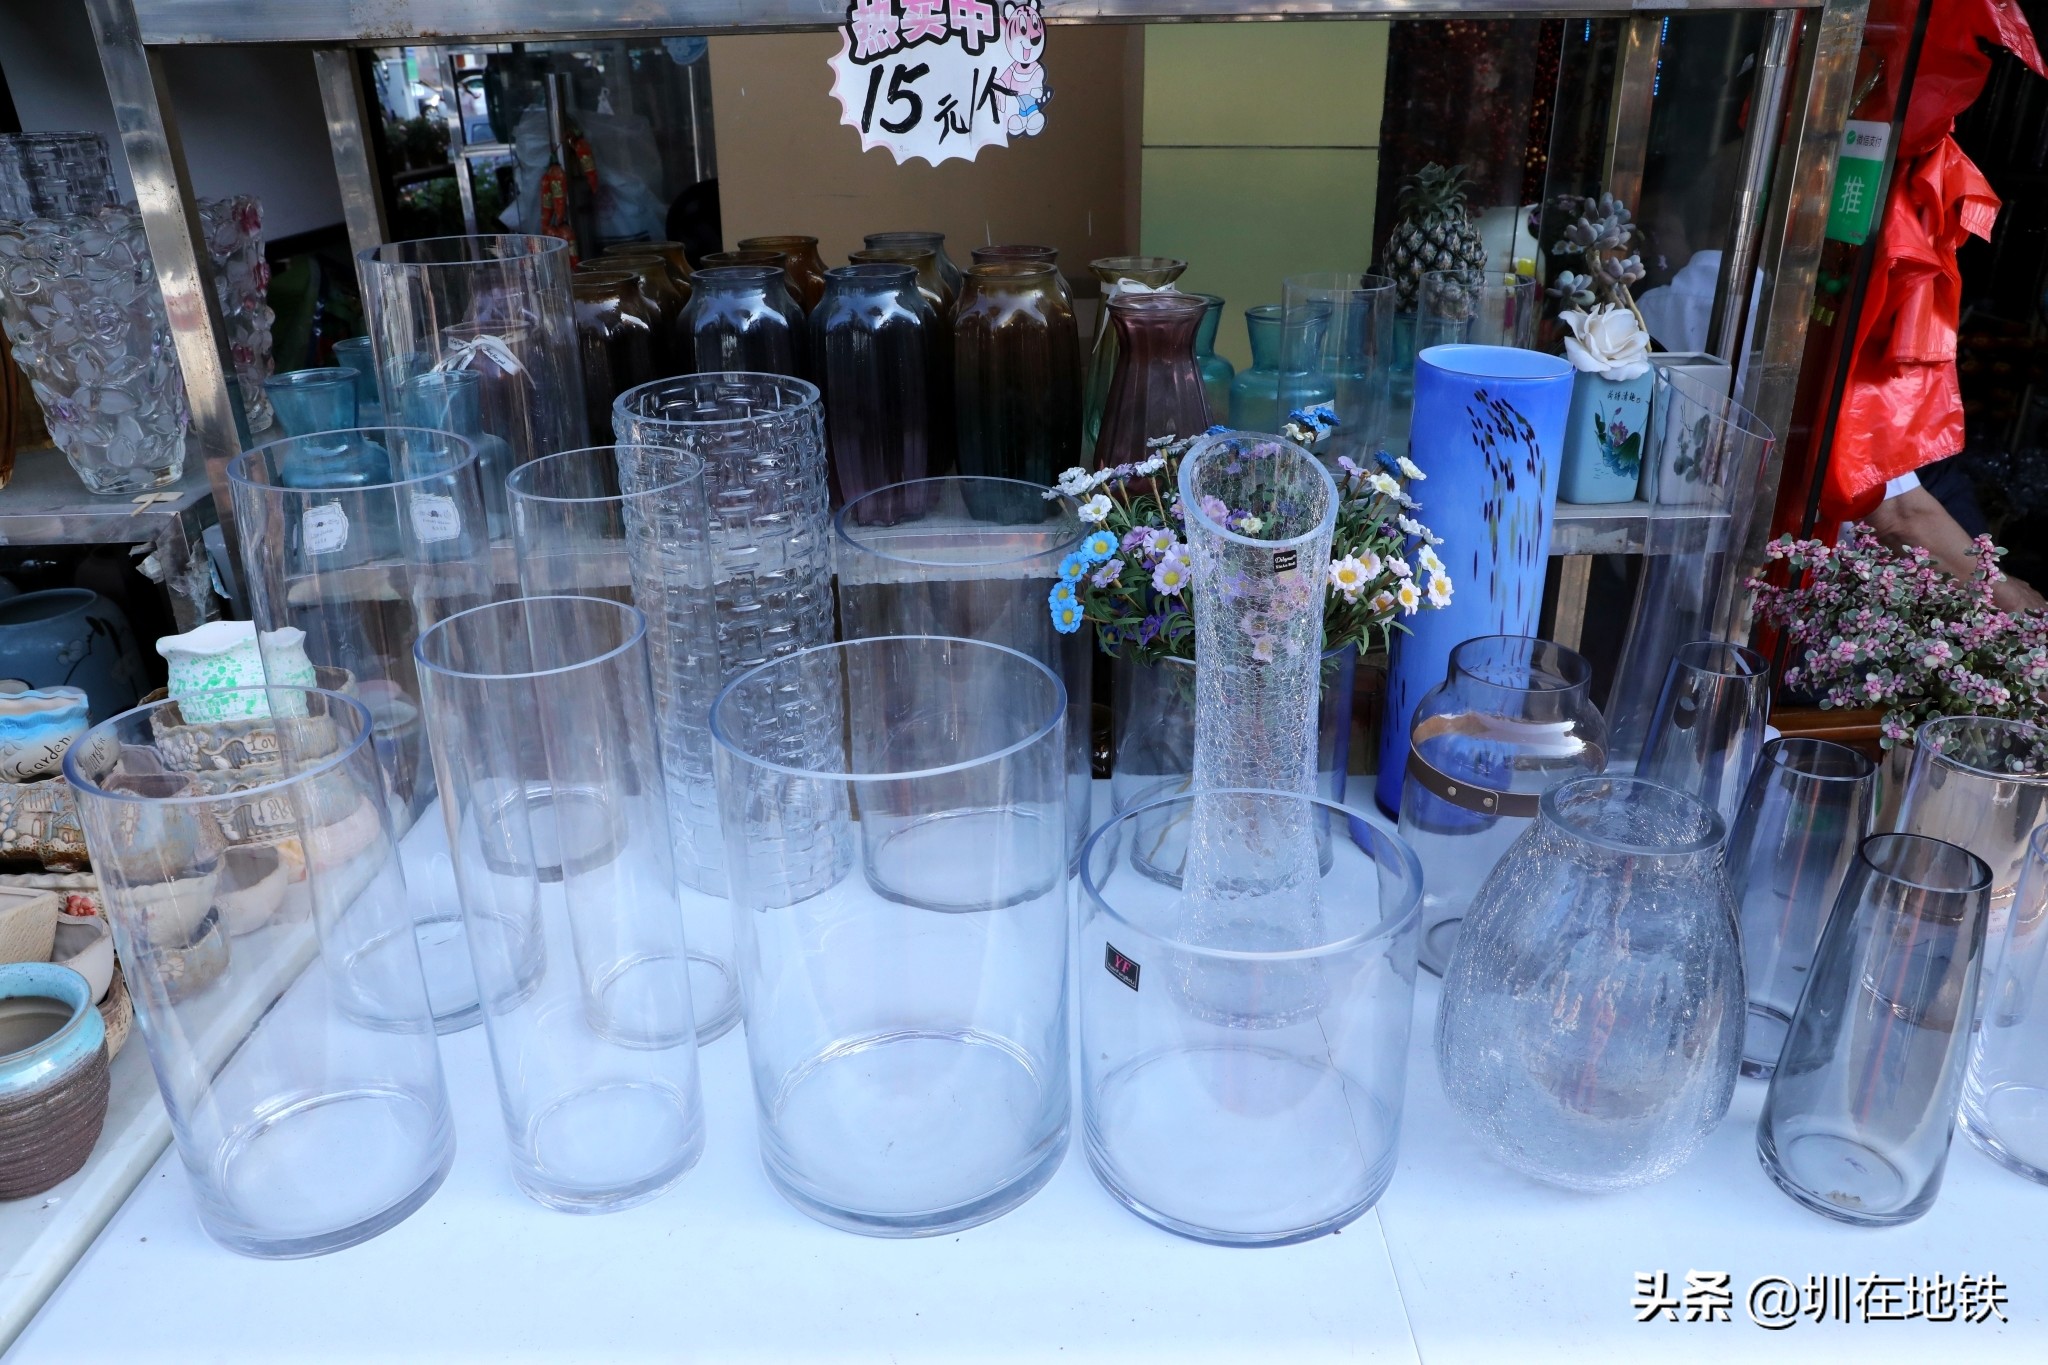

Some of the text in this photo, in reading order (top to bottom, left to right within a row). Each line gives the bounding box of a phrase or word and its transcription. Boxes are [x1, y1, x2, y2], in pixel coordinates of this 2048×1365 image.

[1856, 134, 1883, 148] 微信支付
[1838, 175, 1865, 215] 推
[247, 731, 278, 752] Lov
[16, 734, 71, 776] Garden
[1114, 954, 1132, 974] YF
